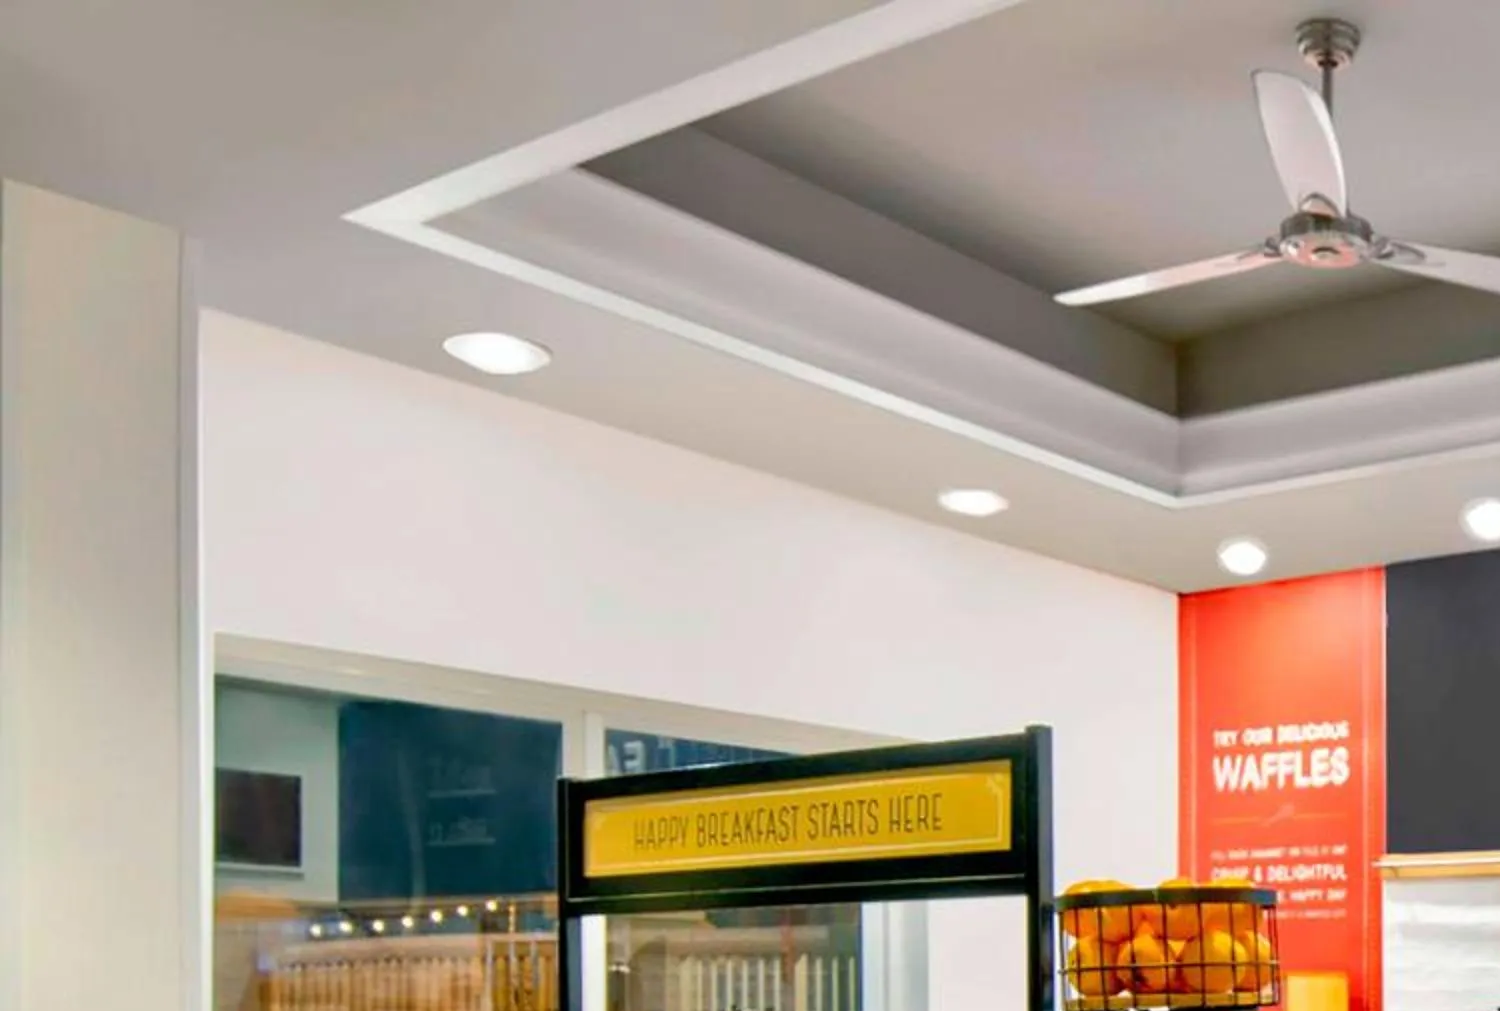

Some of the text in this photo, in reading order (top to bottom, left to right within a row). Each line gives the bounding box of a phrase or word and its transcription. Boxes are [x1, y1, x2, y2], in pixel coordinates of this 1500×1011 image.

[1212, 720, 1349, 748] TRY OUR DELICIOUS
[1212, 746, 1350, 792] WAFFLES
[634, 792, 943, 850] HAPPY BREAKFAST STARTS HERE
[1266, 862, 1347, 883] DELIGHTFUL
